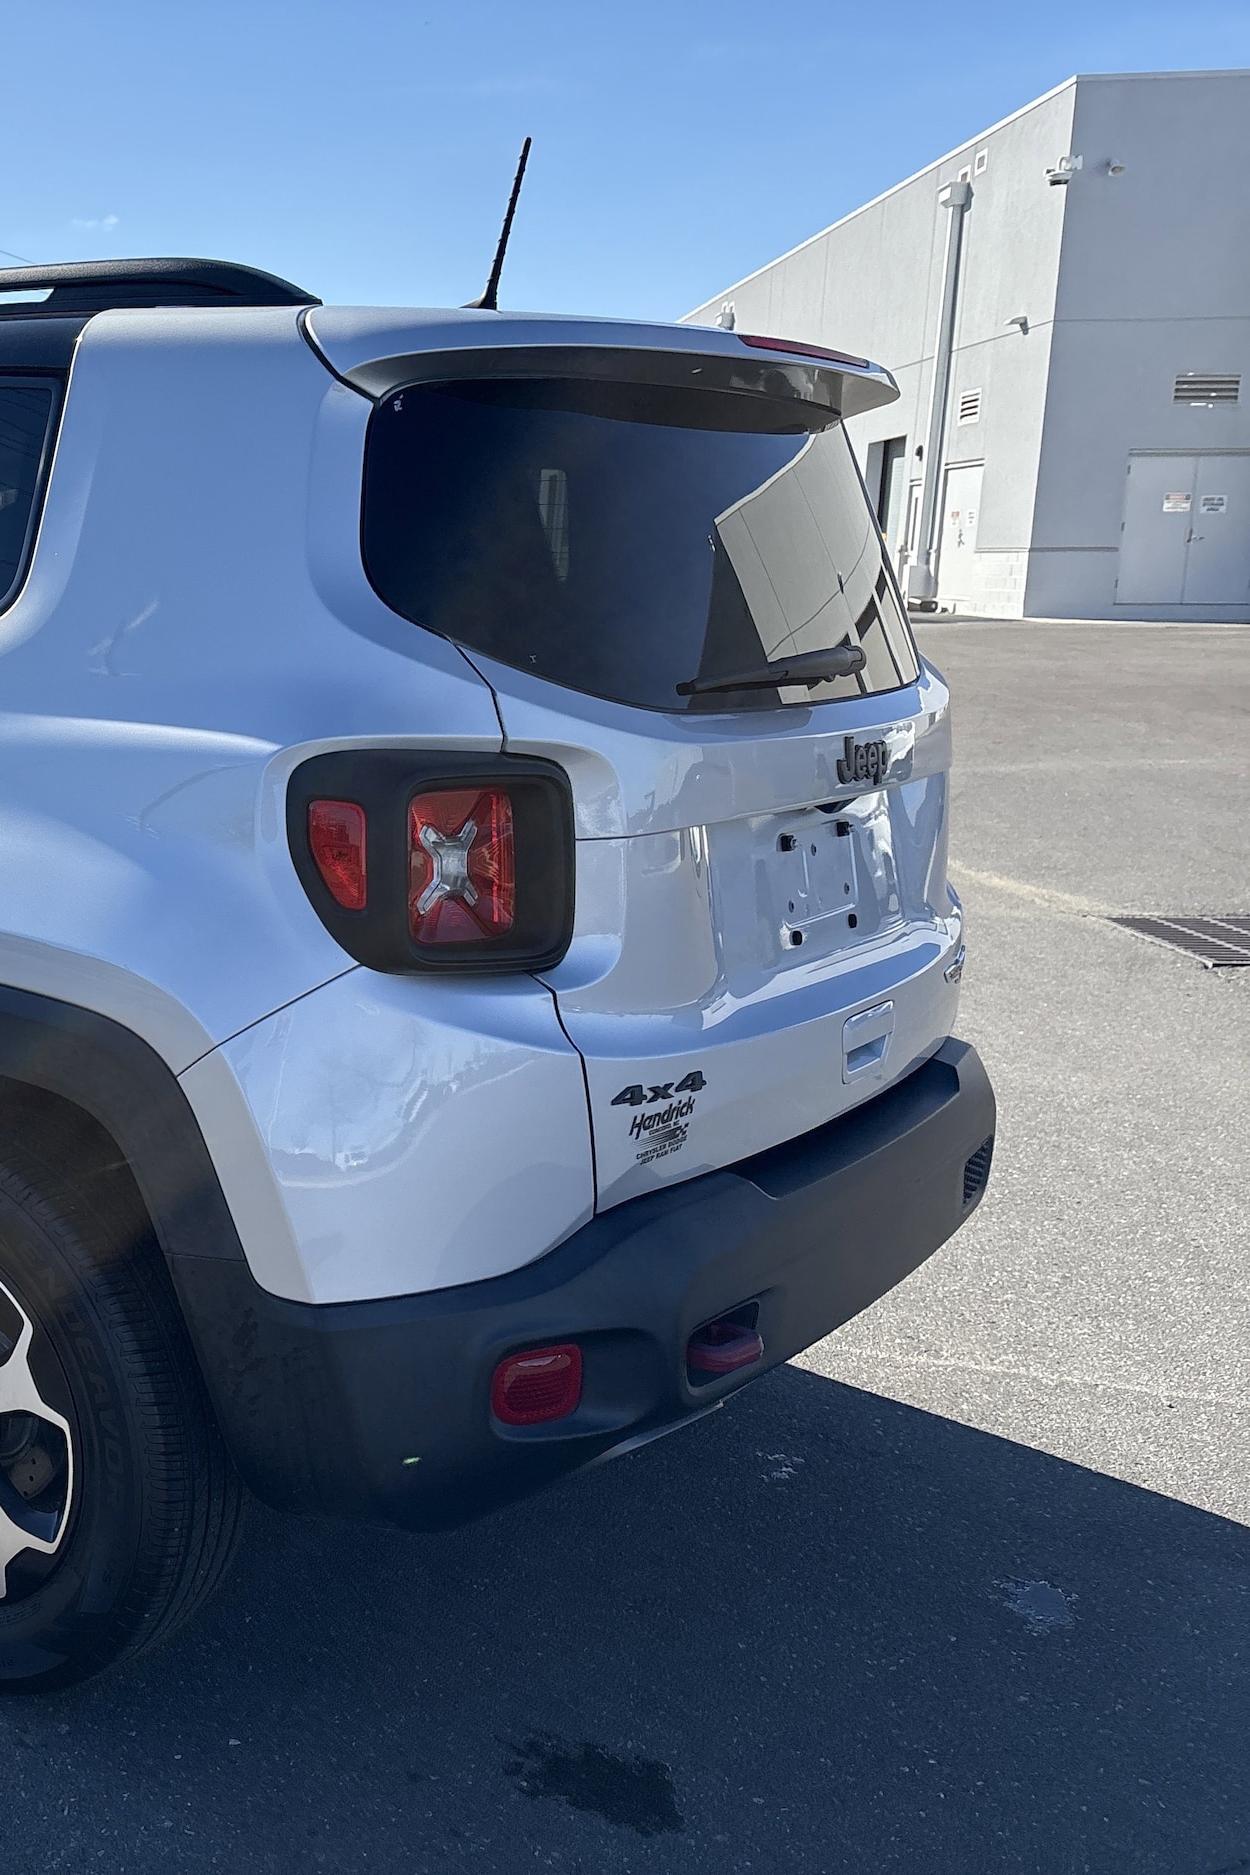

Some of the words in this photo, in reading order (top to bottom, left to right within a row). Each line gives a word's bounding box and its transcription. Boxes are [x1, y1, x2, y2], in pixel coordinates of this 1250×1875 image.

[837, 736, 888, 785] Jeep
[611, 1070, 707, 1106] 4x4
[629, 1095, 696, 1140] Hendrick
[636, 1143, 667, 1160] CHRYSLER
[668, 1135, 688, 1148] DODGE
[639, 1154, 655, 1166] JEEP
[656, 1150, 670, 1160] RAM
[670, 1143, 683, 1155] FIAT
